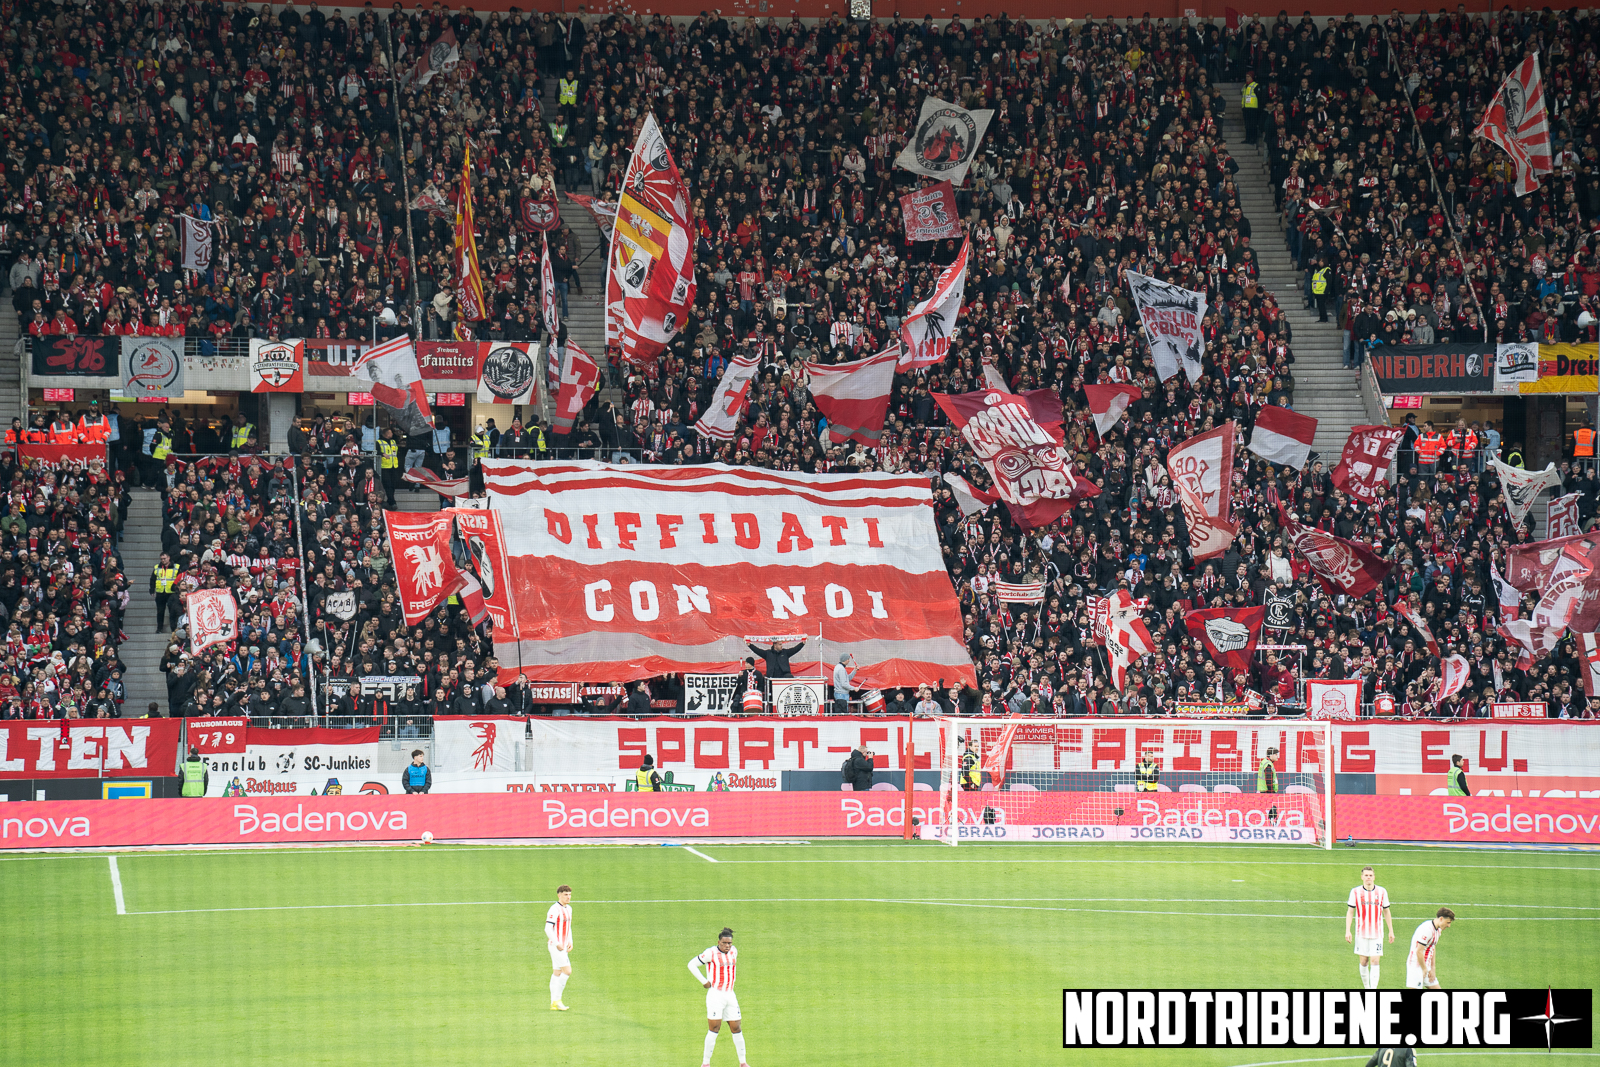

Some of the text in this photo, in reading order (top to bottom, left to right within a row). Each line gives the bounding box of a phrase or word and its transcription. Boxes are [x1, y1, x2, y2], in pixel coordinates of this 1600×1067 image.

[436, 346, 459, 354] Freiburg
[420, 353, 475, 368] Fanatics
[543, 507, 884, 554] DIFFIDATI
[327, 598, 353, 608] ACAB
[583, 579, 889, 622] CON NOI
[687, 676, 737, 688] SCHEISS
[532, 687, 572, 699] EKSTASE
[586, 686, 622, 695] EKSTASE
[190, 720, 243, 729] DRUSOMAGUS
[303, 755, 371, 771] SC-Junkies
[245, 777, 297, 796] Rothaus
[728, 773, 777, 791] Rothaus
[234, 804, 408, 835] Badenova
[542, 799, 709, 829] Badenova
[1443, 803, 1600, 834] Badenov
[1032, 826, 1105, 839] JOBRAD
[1131, 827, 1203, 840] JOBRAD
[1229, 828, 1303, 841] JOBRAD
